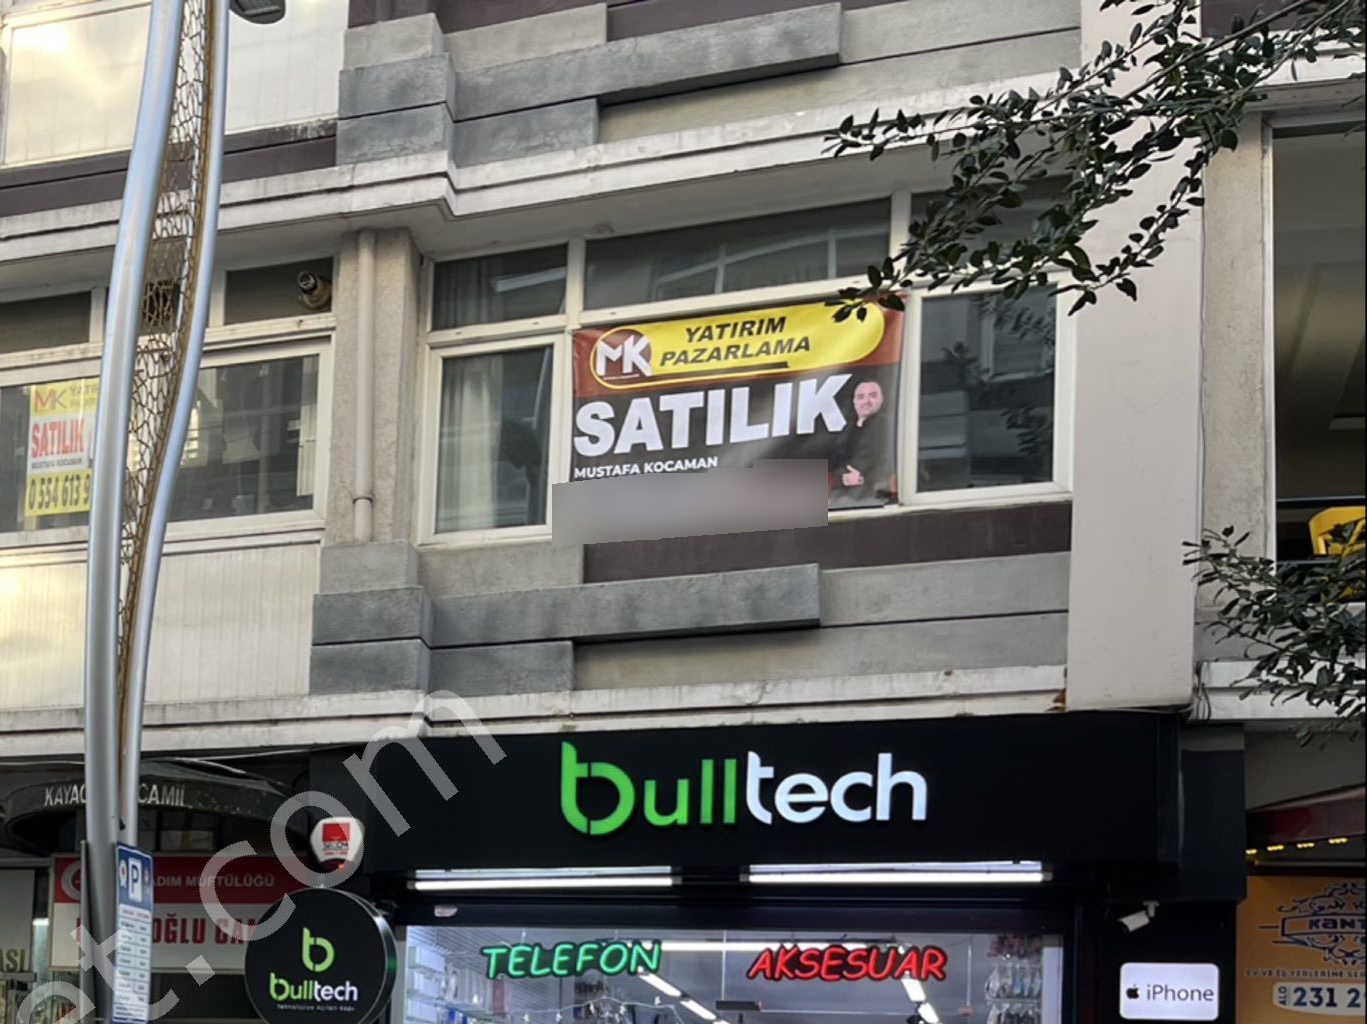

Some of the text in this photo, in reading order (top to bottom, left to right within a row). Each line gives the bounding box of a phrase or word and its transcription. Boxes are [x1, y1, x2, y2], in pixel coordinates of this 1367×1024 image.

[685, 317, 787, 343] YATIRIM
[595, 335, 652, 377] MK
[659, 336, 811, 367] PAZARLAMA
[573, 373, 854, 457] SATILIK
[31, 417, 85, 459] SATILIK
[574, 456, 718, 479] MUSTAFA KOCAMAN
[560, 741, 927, 835] bulltech
[481, 940, 661, 979] TELEFON
[747, 946, 947, 982] AKSESUAR
[269, 971, 359, 1002] bulltech
[1146, 984, 1214, 1001] iPhone
[1293, 986, 1338, 1007] 231
